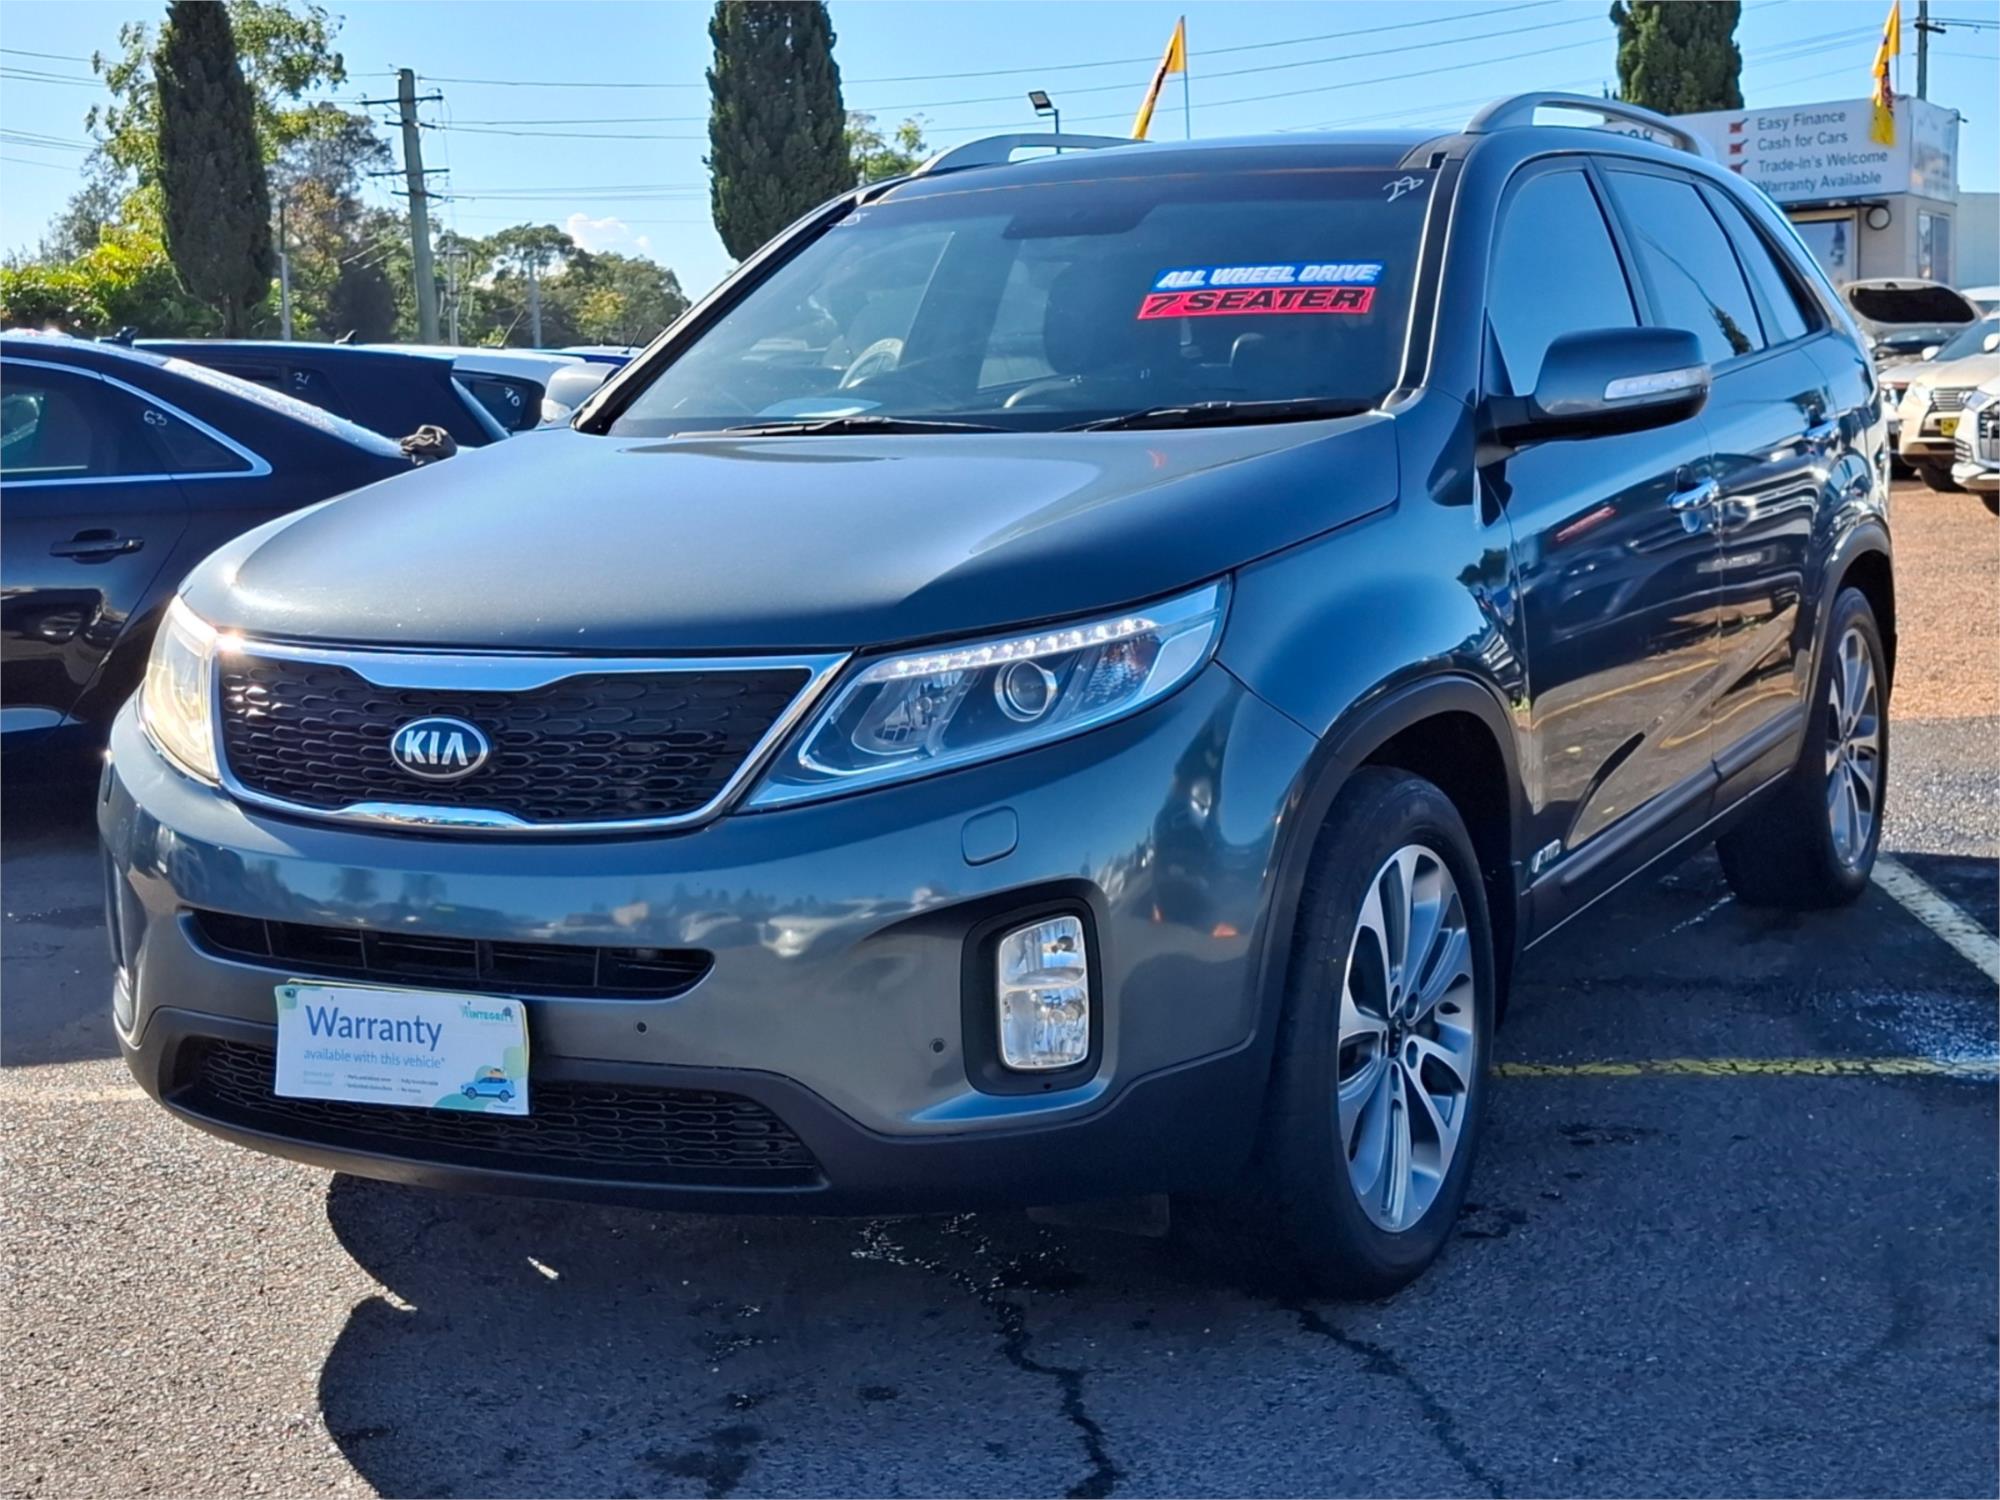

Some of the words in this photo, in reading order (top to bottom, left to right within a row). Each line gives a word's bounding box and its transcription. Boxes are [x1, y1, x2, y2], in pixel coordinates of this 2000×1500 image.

[1757, 117, 1790, 131] Easy
[1793, 111, 1846, 127] Finance
[1757, 136, 1791, 151] Cash
[1795, 134, 1812, 147] for
[1817, 131, 1848, 145] Cars
[1826, 151, 1888, 167] Welcome
[1757, 177, 1817, 193] Warranty
[1820, 171, 1882, 189] Available
[1156, 270, 1206, 288] ALL
[1210, 266, 1296, 285] WHEEL
[1298, 264, 1382, 283] DRIVE
[1147, 294, 1181, 315] 7
[1184, 289, 1366, 312] SEATER
[143, 409, 168, 426] 63
[404, 730, 469, 766] KIA
[305, 1004, 442, 1051] Warranty
[303, 1048, 350, 1062] available
[353, 1050, 377, 1064] with
[380, 1052, 400, 1066] this
